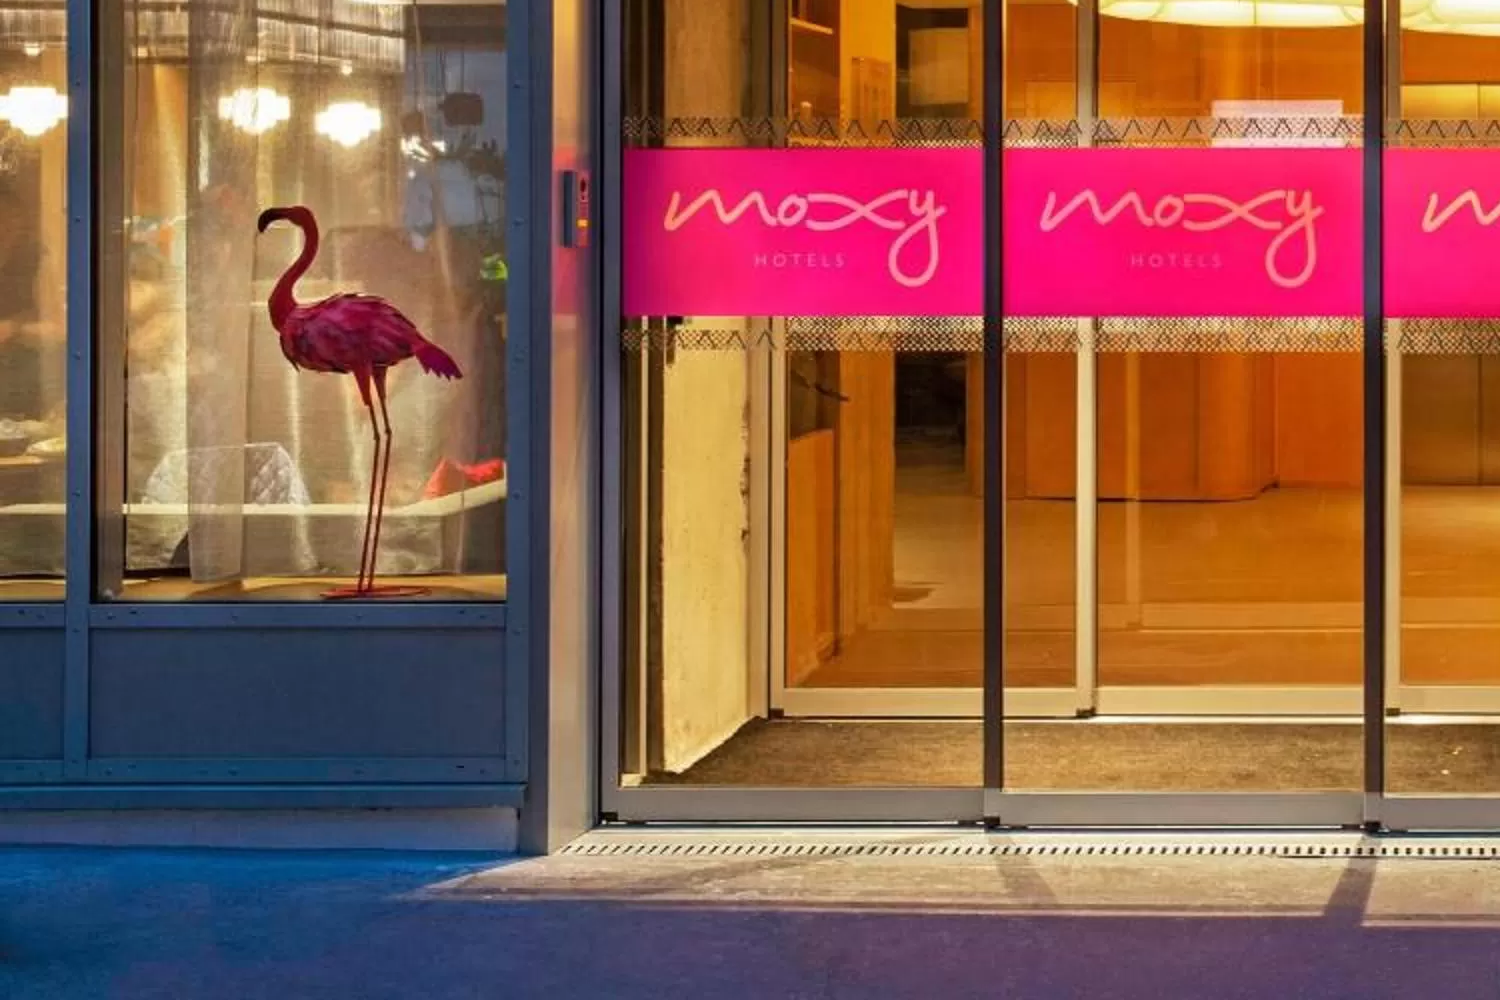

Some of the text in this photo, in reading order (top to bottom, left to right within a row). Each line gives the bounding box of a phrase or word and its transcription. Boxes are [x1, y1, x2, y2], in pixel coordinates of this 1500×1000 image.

[662, 188, 947, 288] moxy
[753, 252, 846, 269] HOTELS
[1039, 189, 1324, 289] moxy
[1130, 253, 1223, 270] HOTELS
